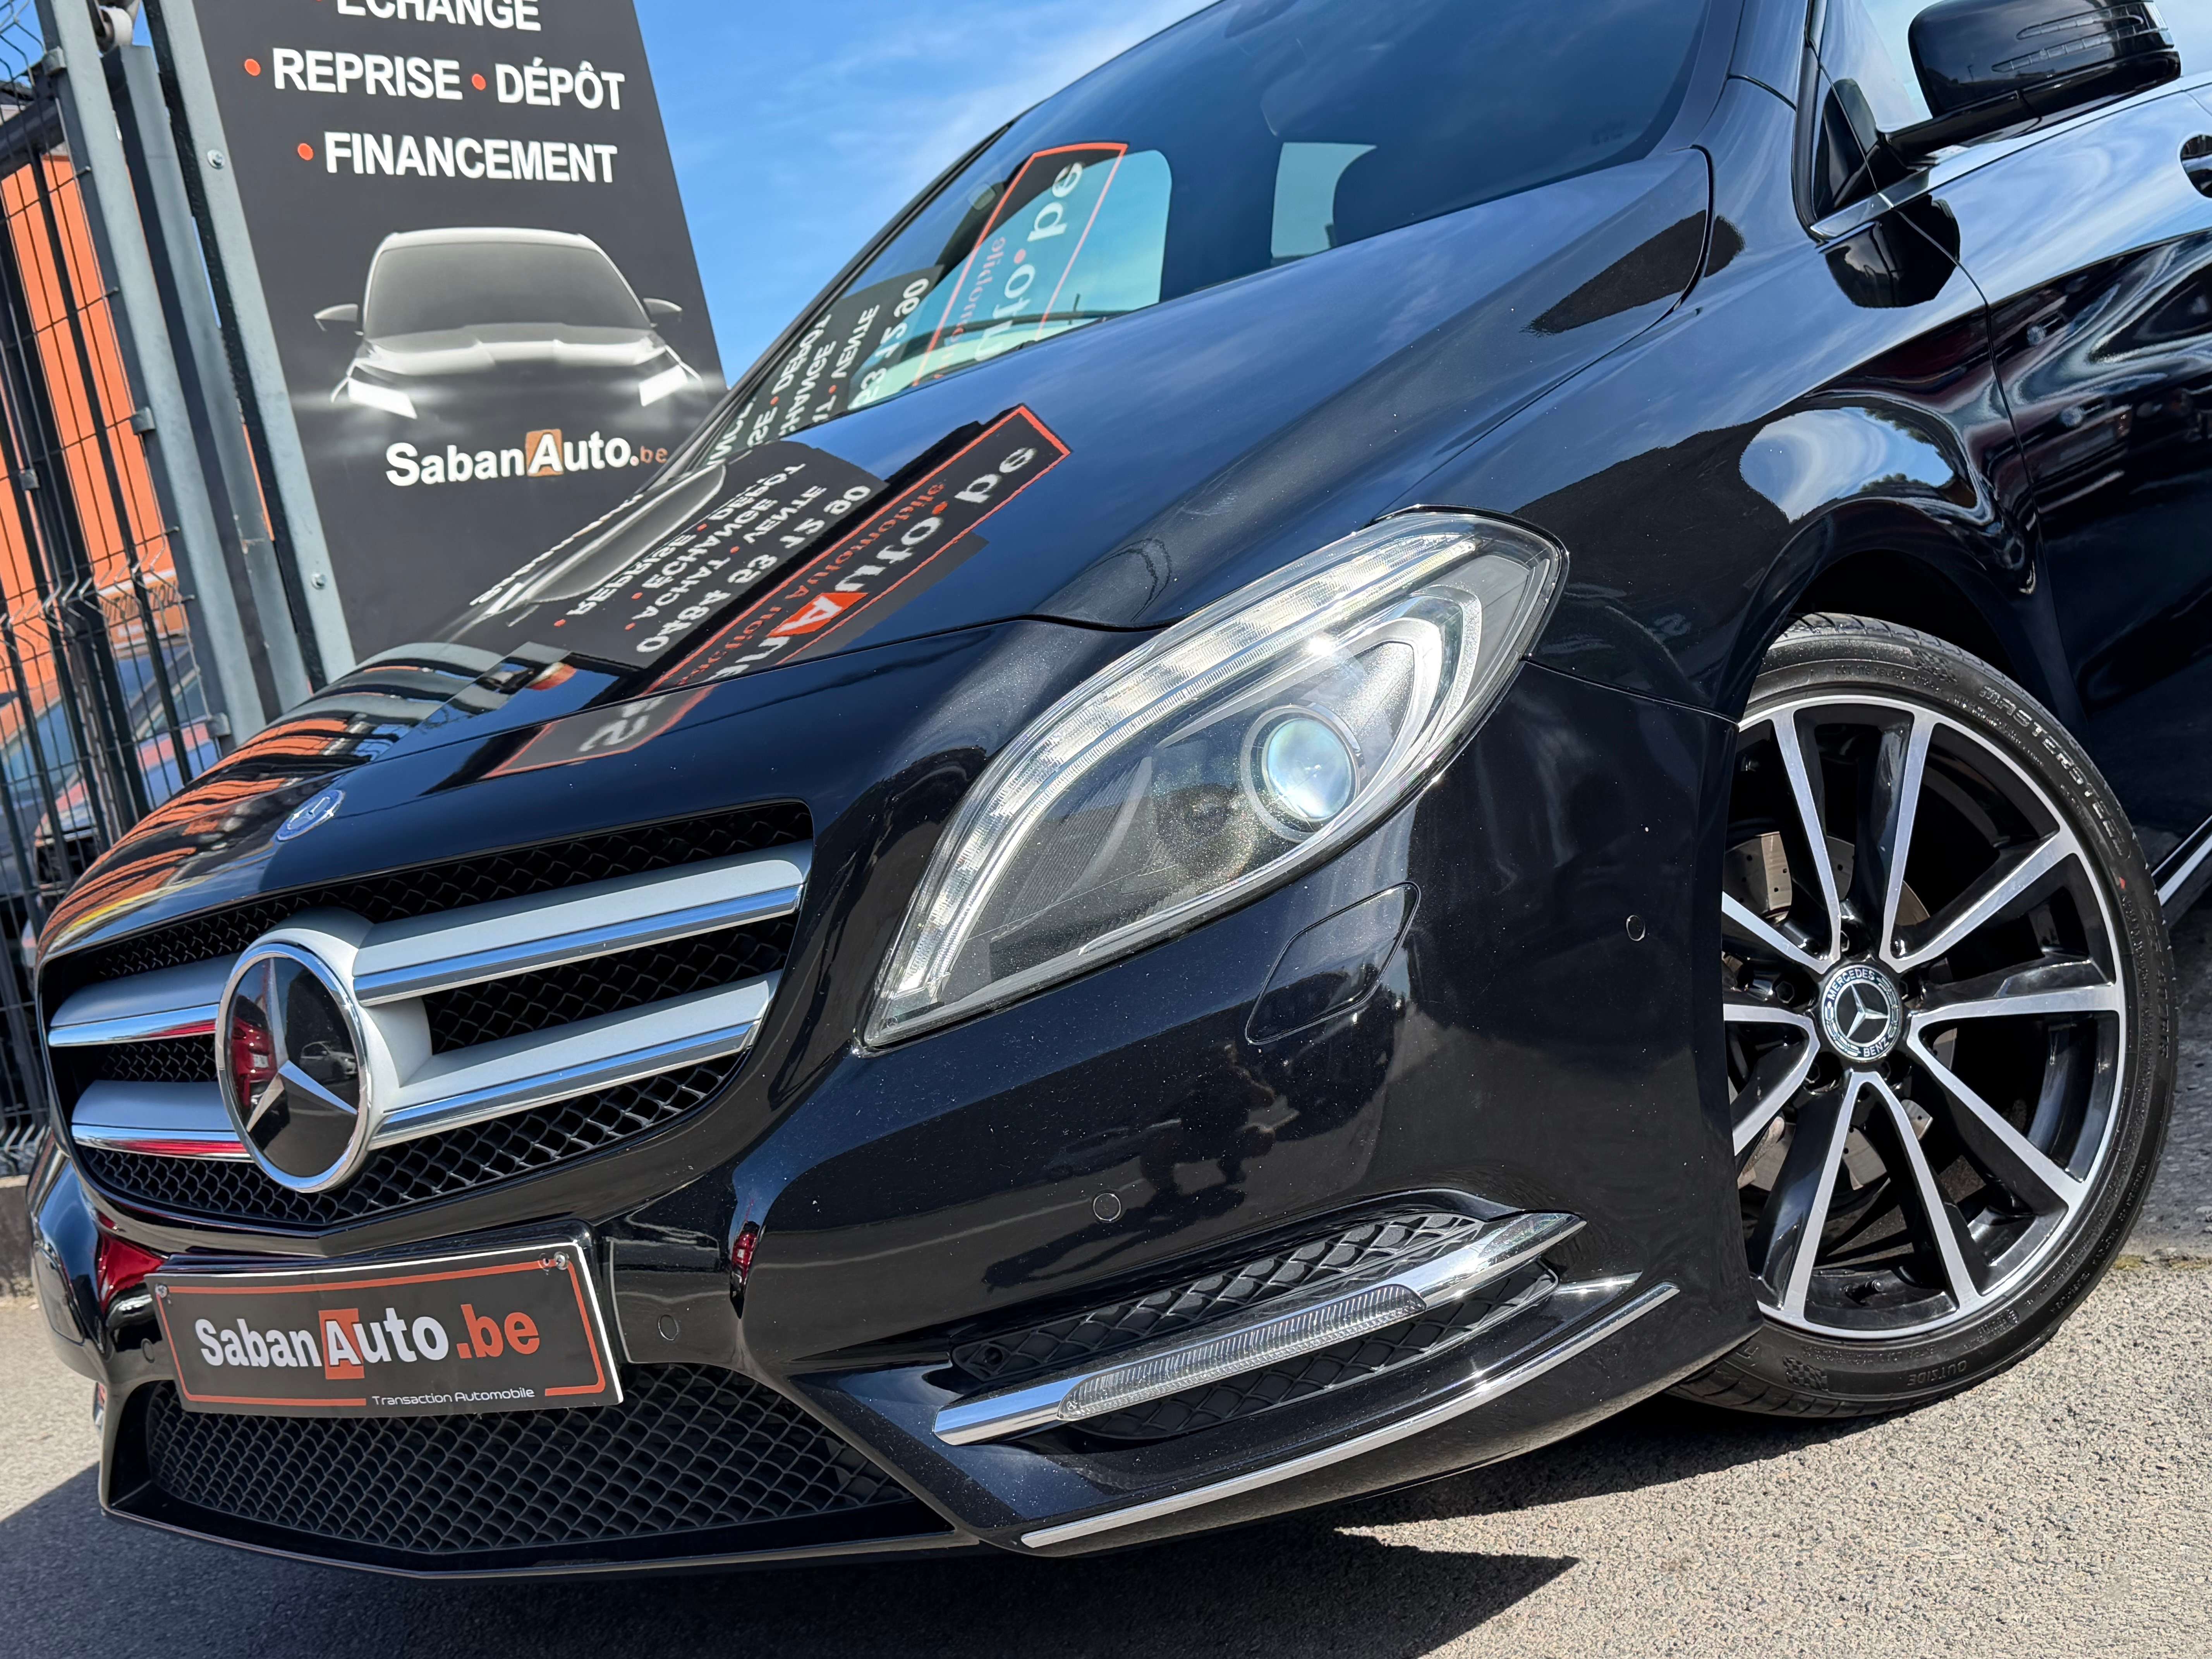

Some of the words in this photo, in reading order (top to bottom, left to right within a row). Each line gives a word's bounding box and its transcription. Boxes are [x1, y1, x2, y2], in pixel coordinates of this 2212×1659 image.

[272, 47, 464, 101] REPRISE
[495, 56, 625, 110] DÉPÔT
[324, 131, 618, 183] FINANCEMENT
[385, 429, 668, 487] SabanAuto.be
[1827, 968, 1875, 1000] MERCEDES
[1863, 1037, 1890, 1058] BENZ
[1907, 1360, 1967, 1386] OUTSIDE
[372, 1392, 453, 1406] Transaction
[454, 1387, 535, 1403] Automobile
